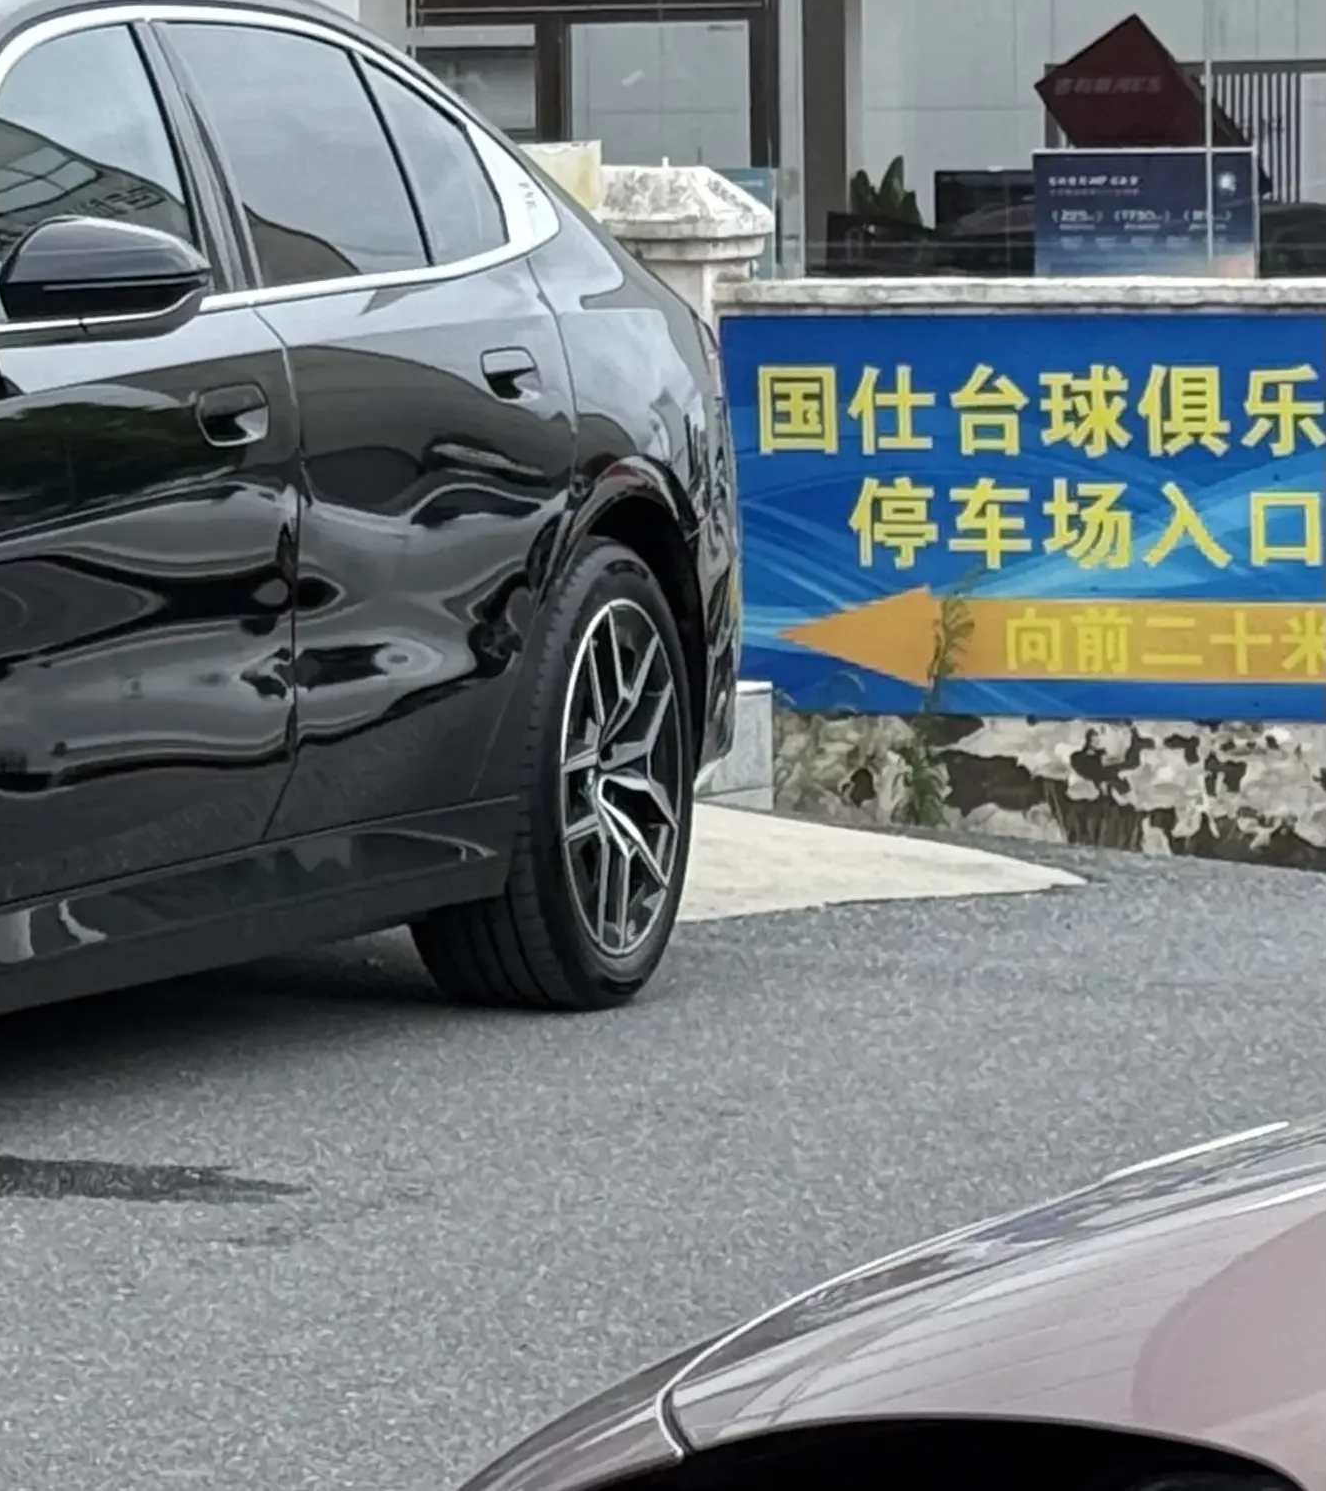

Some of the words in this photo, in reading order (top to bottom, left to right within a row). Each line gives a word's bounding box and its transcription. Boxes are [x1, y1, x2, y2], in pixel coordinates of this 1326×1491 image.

[757, 364, 1326, 457] 国仕台球俱乐
[849, 476, 1323, 569] 停车场入口
[1005, 608, 1326, 675] 向前二十米
